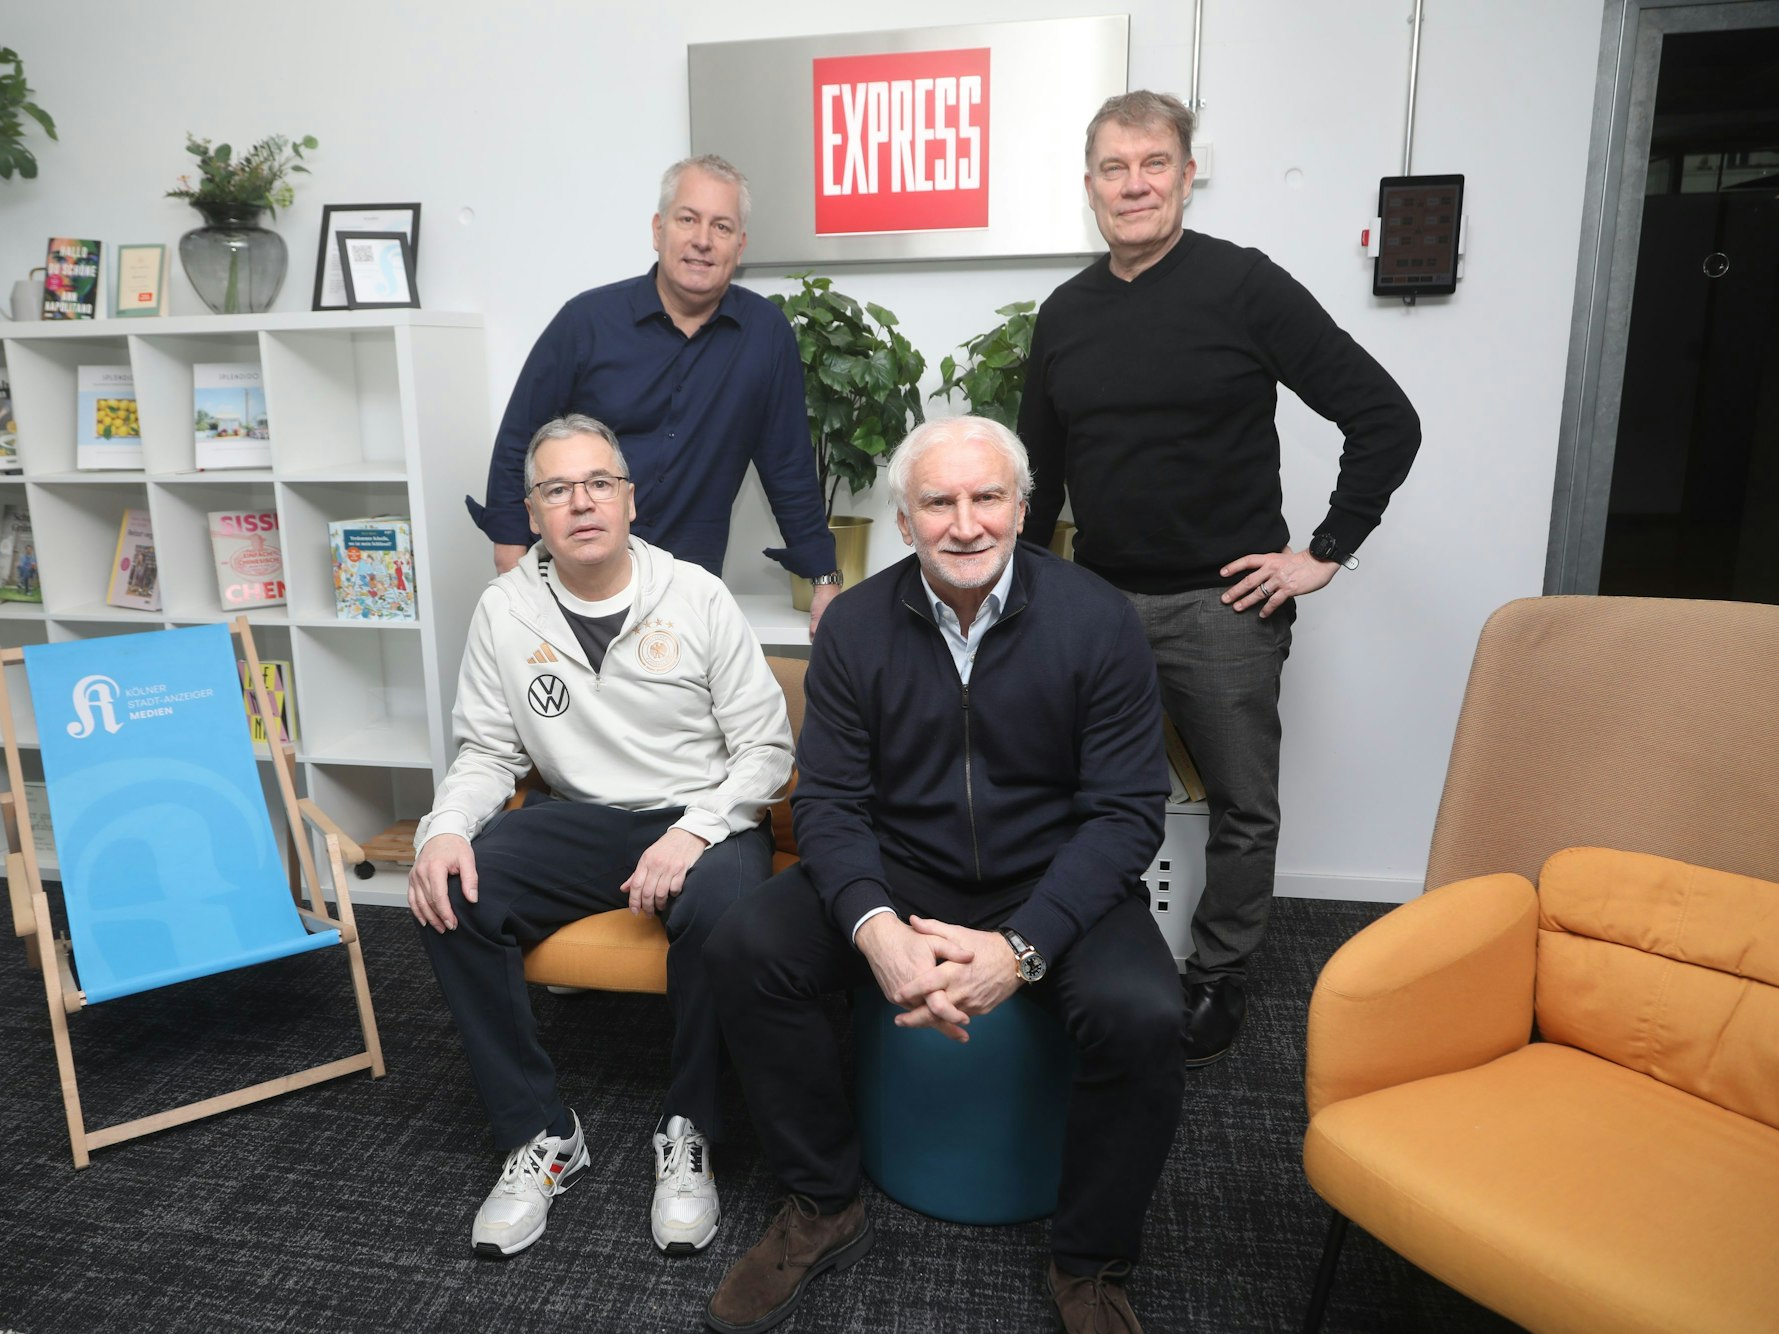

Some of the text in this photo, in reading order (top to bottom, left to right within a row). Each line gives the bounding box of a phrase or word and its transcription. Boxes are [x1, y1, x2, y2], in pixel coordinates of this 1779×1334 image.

[822, 75, 981, 196] EXPRESS
[59, 246, 89, 258] HALLO
[48, 263, 97, 277] DU SCHÖNE
[61, 292, 78, 302] ANN
[44, 301, 93, 314] NAPOLITANO
[125, 684, 167, 697] KÖLNER
[127, 688, 214, 708] STADT-ANZEIGER
[129, 707, 174, 720] MEDIEN
